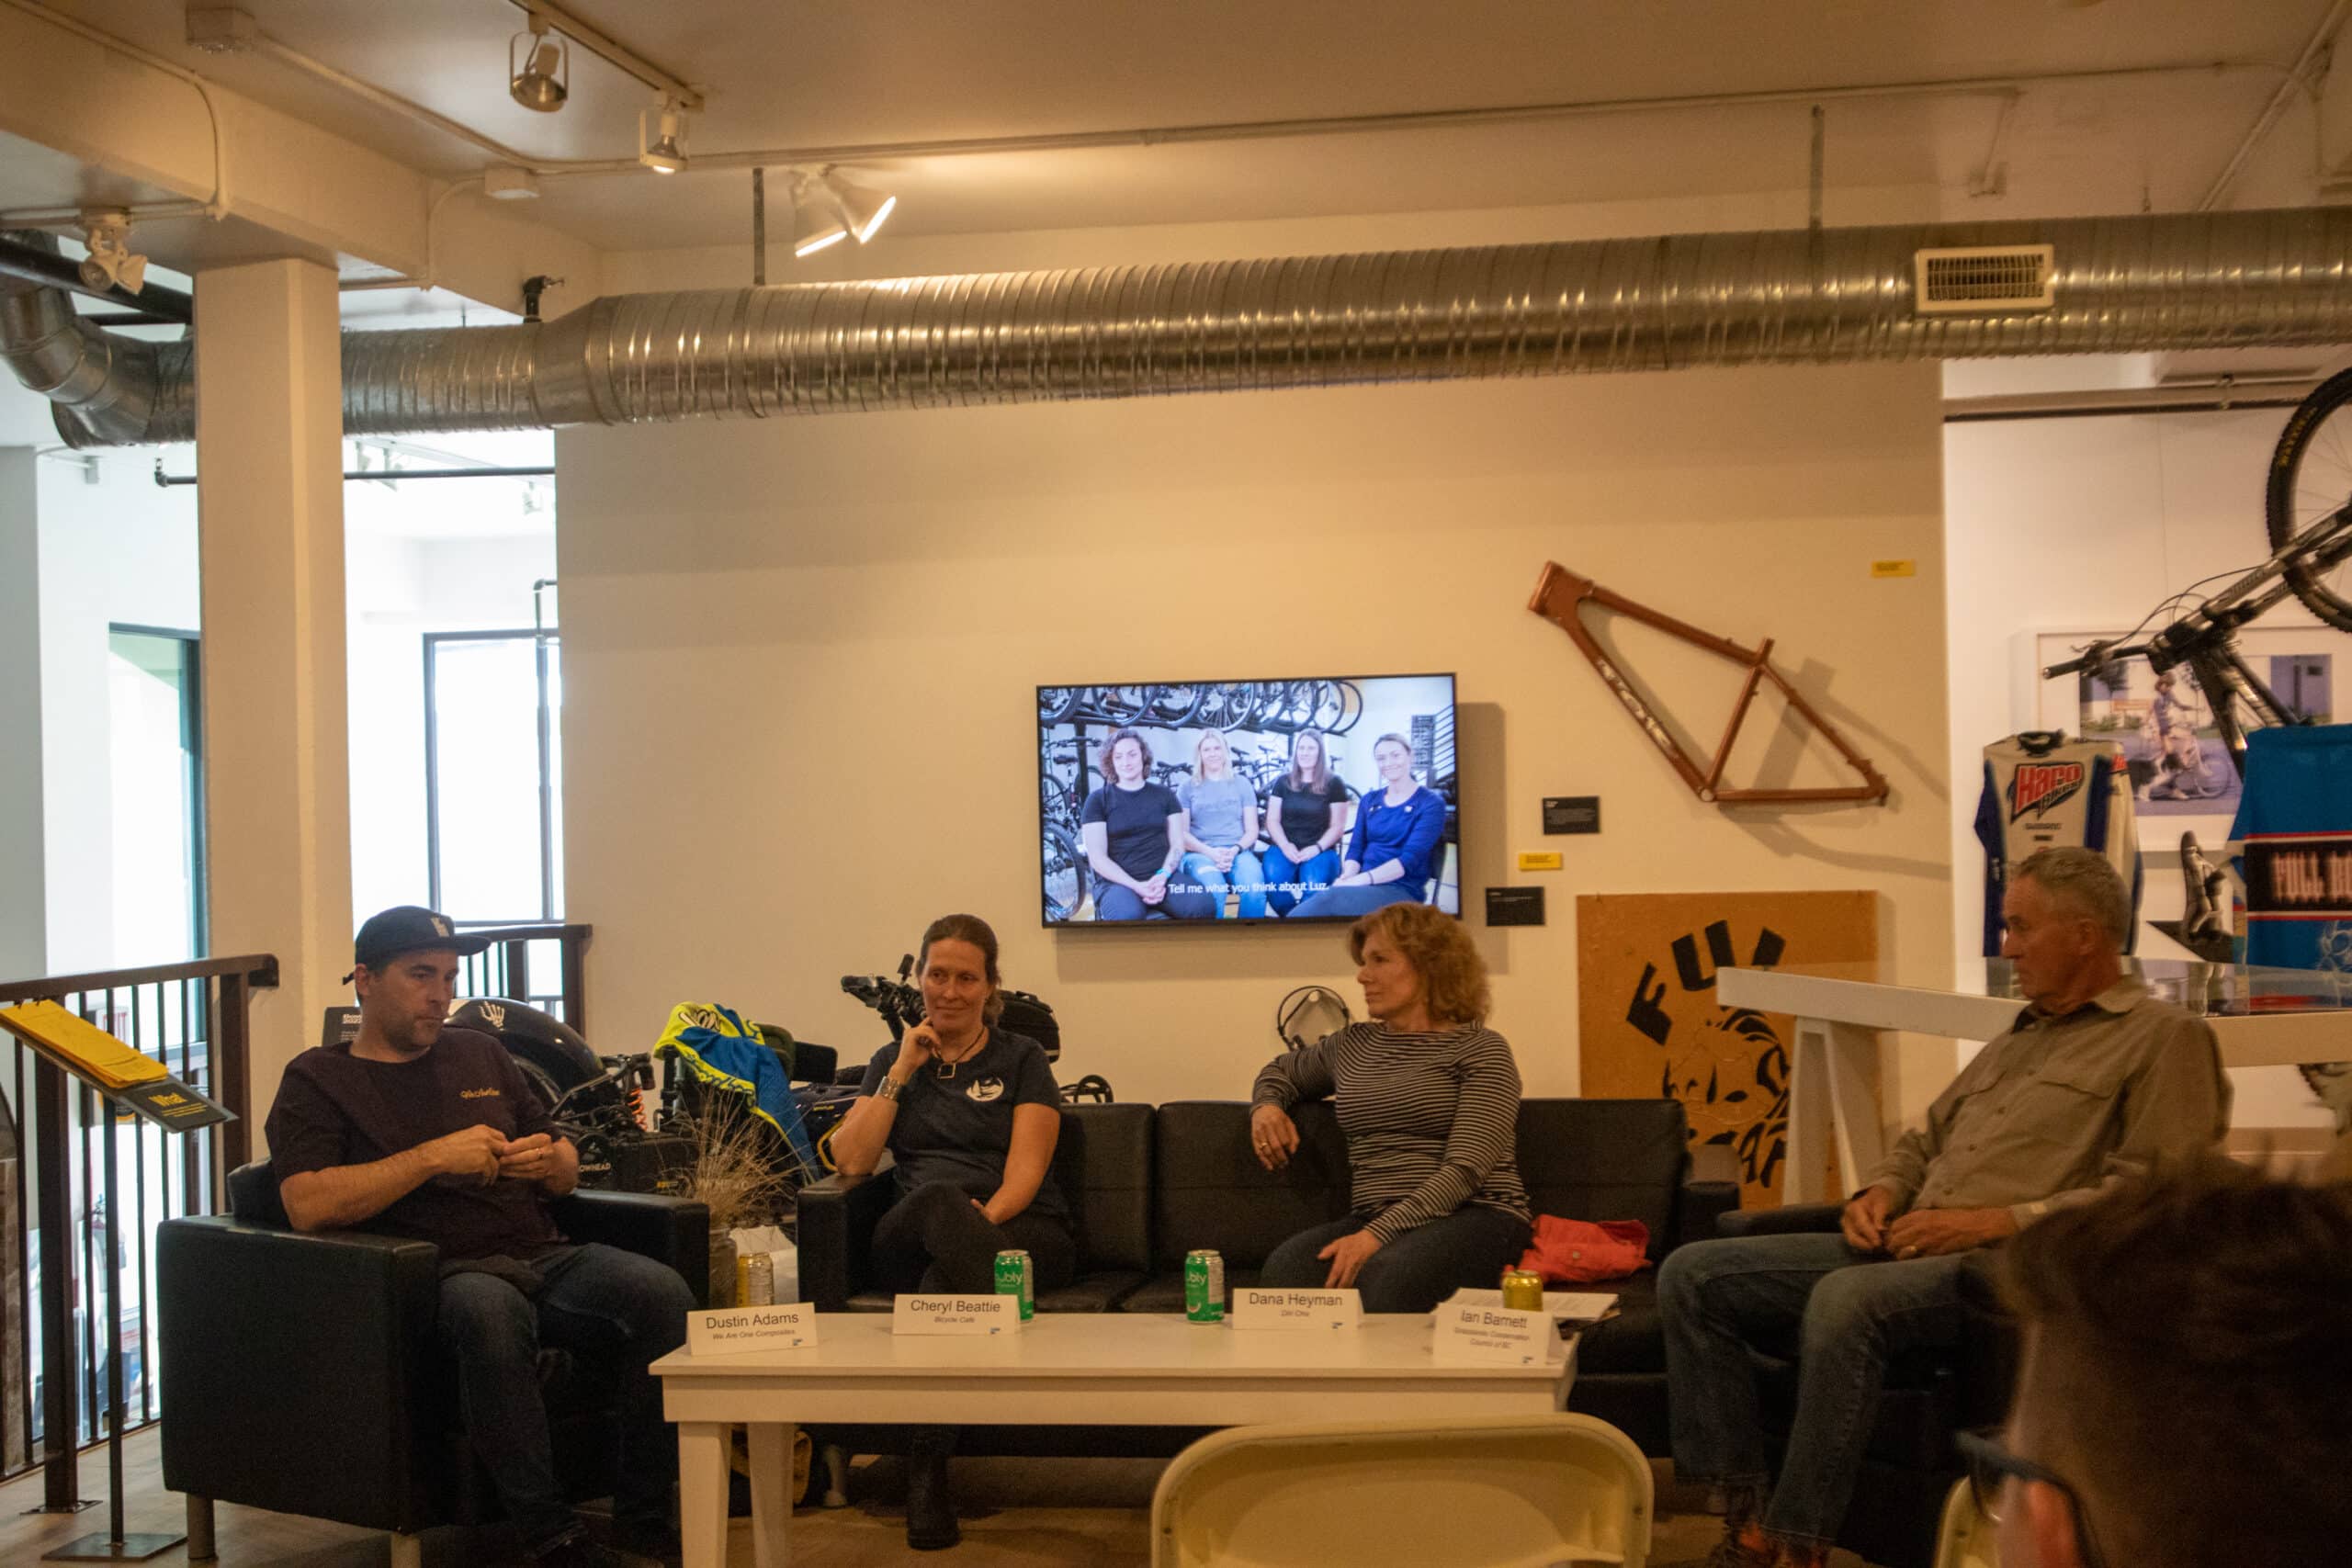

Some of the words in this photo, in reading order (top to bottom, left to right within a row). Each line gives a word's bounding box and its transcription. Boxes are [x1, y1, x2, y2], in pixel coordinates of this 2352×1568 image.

[1168, 884, 1185, 894] Tell
[1188, 886, 1204, 894] me
[1205, 884, 1229, 893] what
[1231, 885, 1250, 895] you
[1252, 883, 1277, 892] think
[1279, 882, 1306, 892] about
[910, 1300, 952, 1314] Cheryl
[956, 1300, 1001, 1313] Beattie
[1250, 1292, 1283, 1305] Dana
[1288, 1293, 1342, 1308] Heyman
[706, 1314, 749, 1329] Dustin
[752, 1313, 799, 1325] Adams
[1461, 1309, 1480, 1323] Ian
[1484, 1312, 1528, 1328] Barnett
